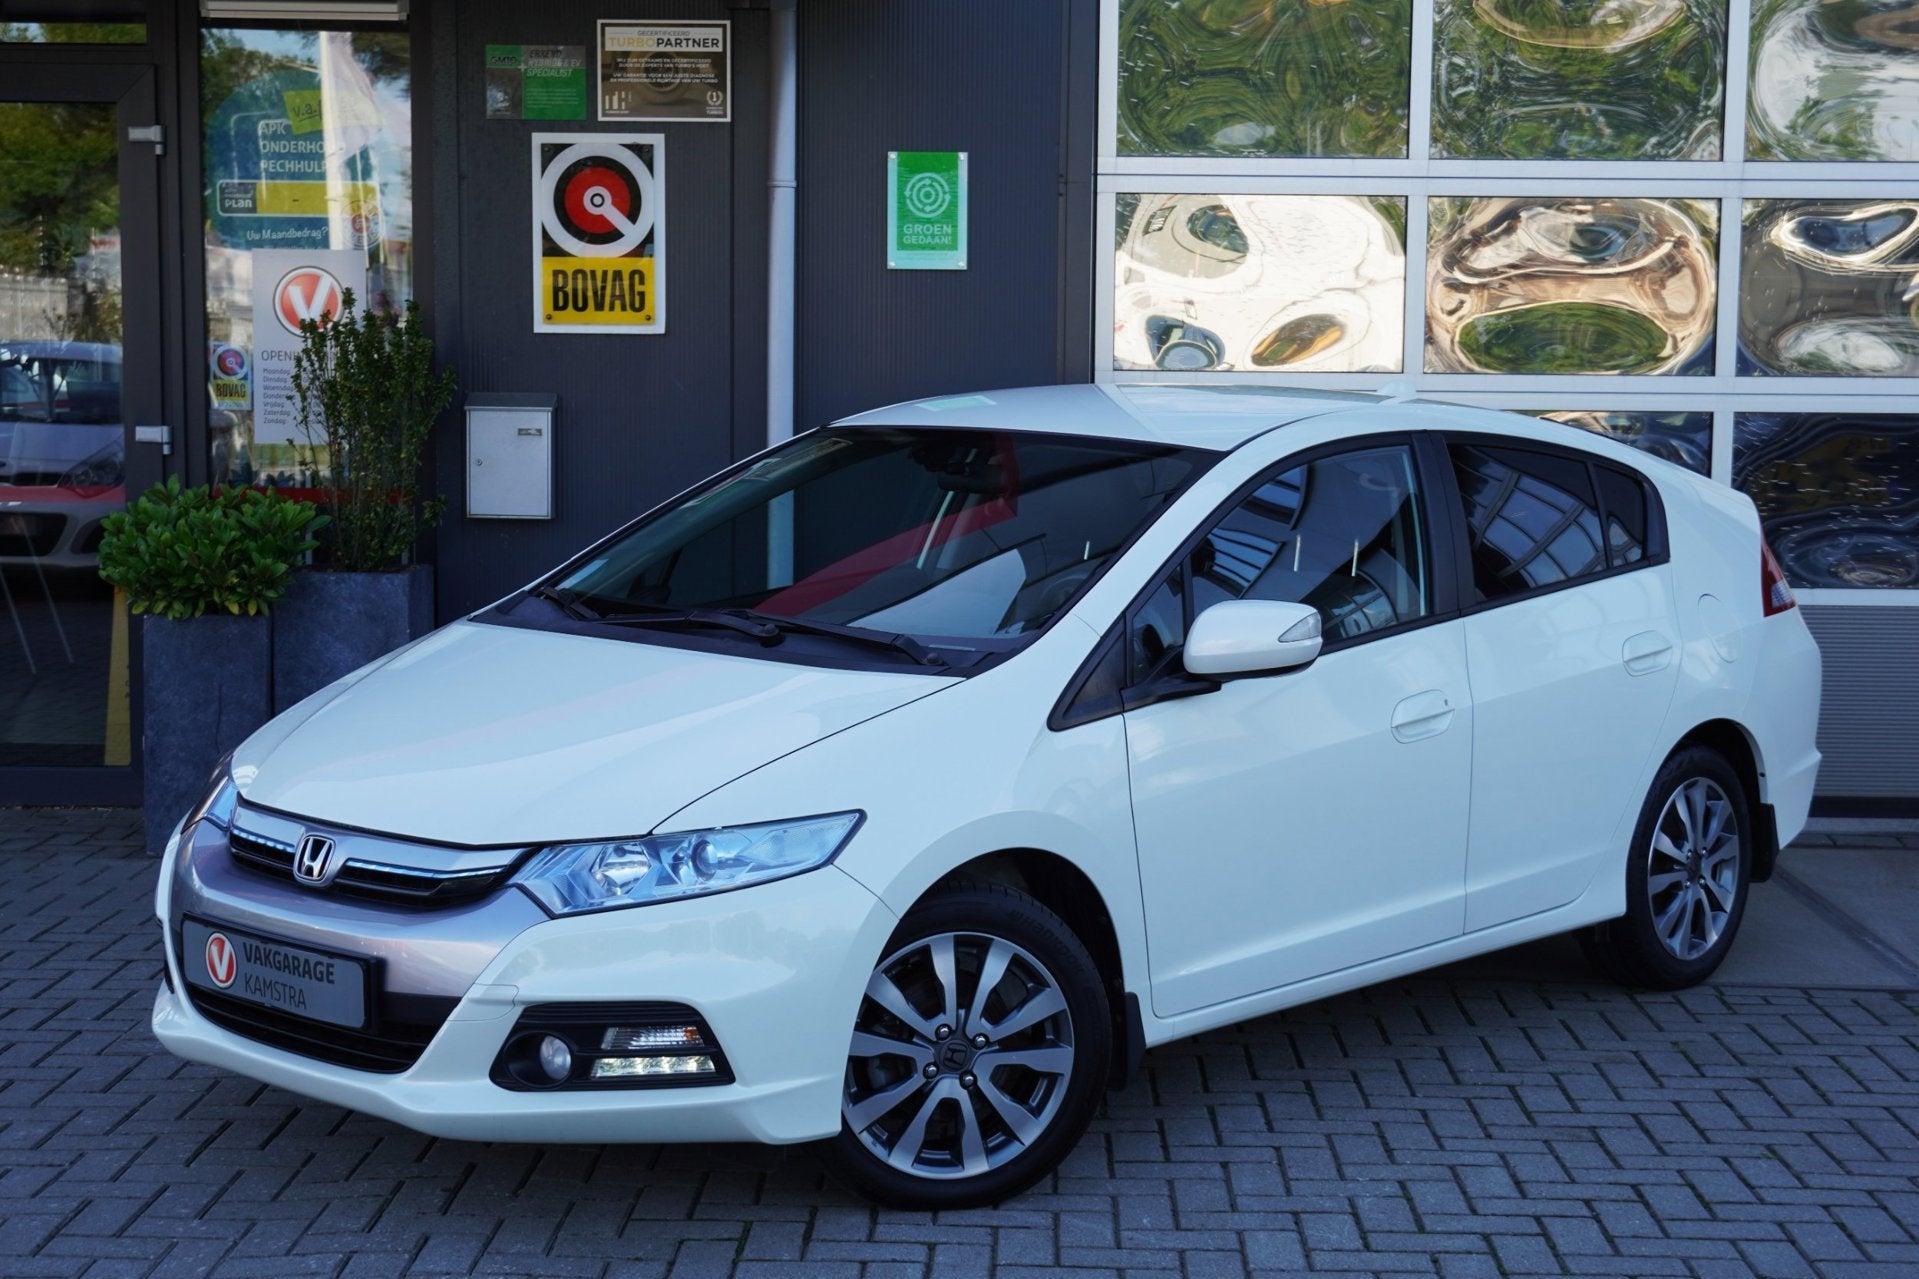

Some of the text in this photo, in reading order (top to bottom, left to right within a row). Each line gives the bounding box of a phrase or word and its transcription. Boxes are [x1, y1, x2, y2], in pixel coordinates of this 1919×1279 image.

[261, 123, 286, 135] APK
[260, 141, 325, 153] ONDERHO
[904, 224, 952, 235] GROEN
[552, 269, 646, 313] BOVAG
[216, 383, 246, 398] BOVAG
[243, 942, 336, 985] VAKGARAGE
[244, 972, 308, 1010] KAMSTRA
